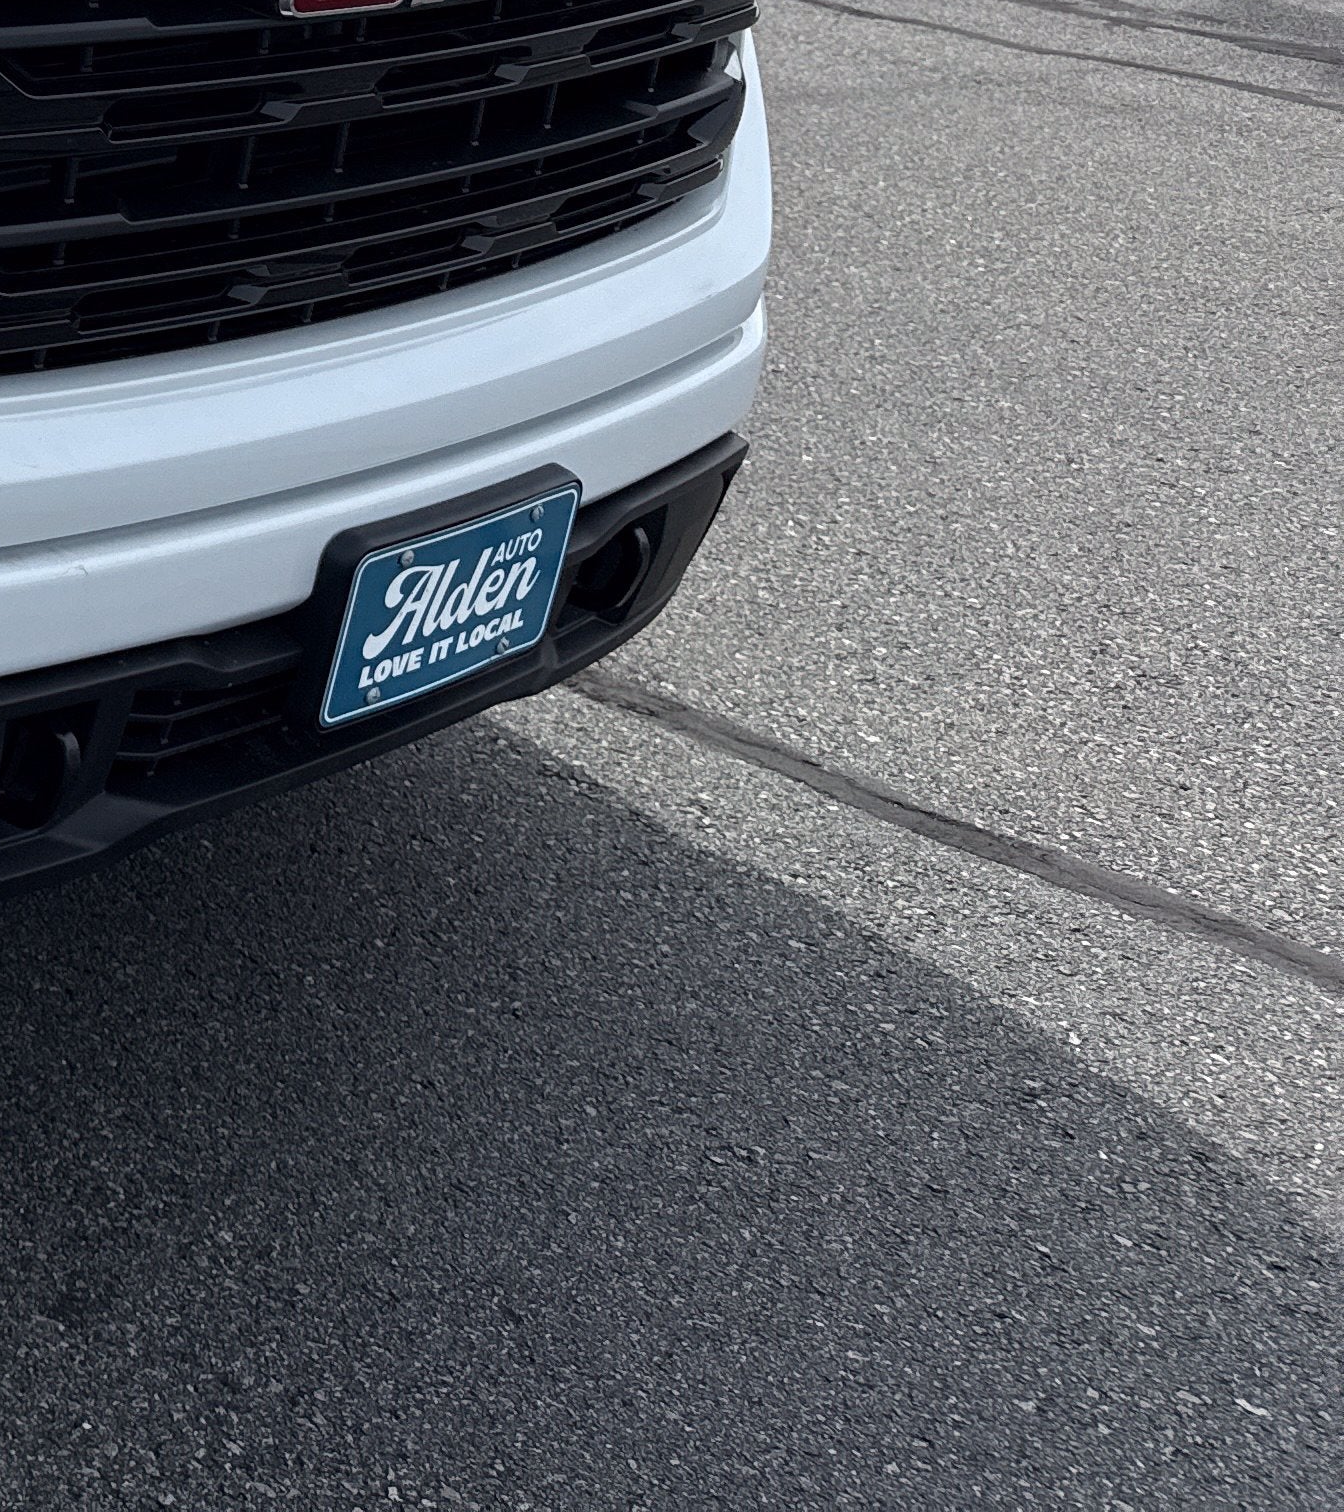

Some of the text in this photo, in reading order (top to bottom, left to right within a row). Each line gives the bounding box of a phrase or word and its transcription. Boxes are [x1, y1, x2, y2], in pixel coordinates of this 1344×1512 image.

[491, 528, 543, 565] AUTO
[362, 546, 541, 660] Alden
[358, 609, 525, 689] LOVE IT LOCAL
